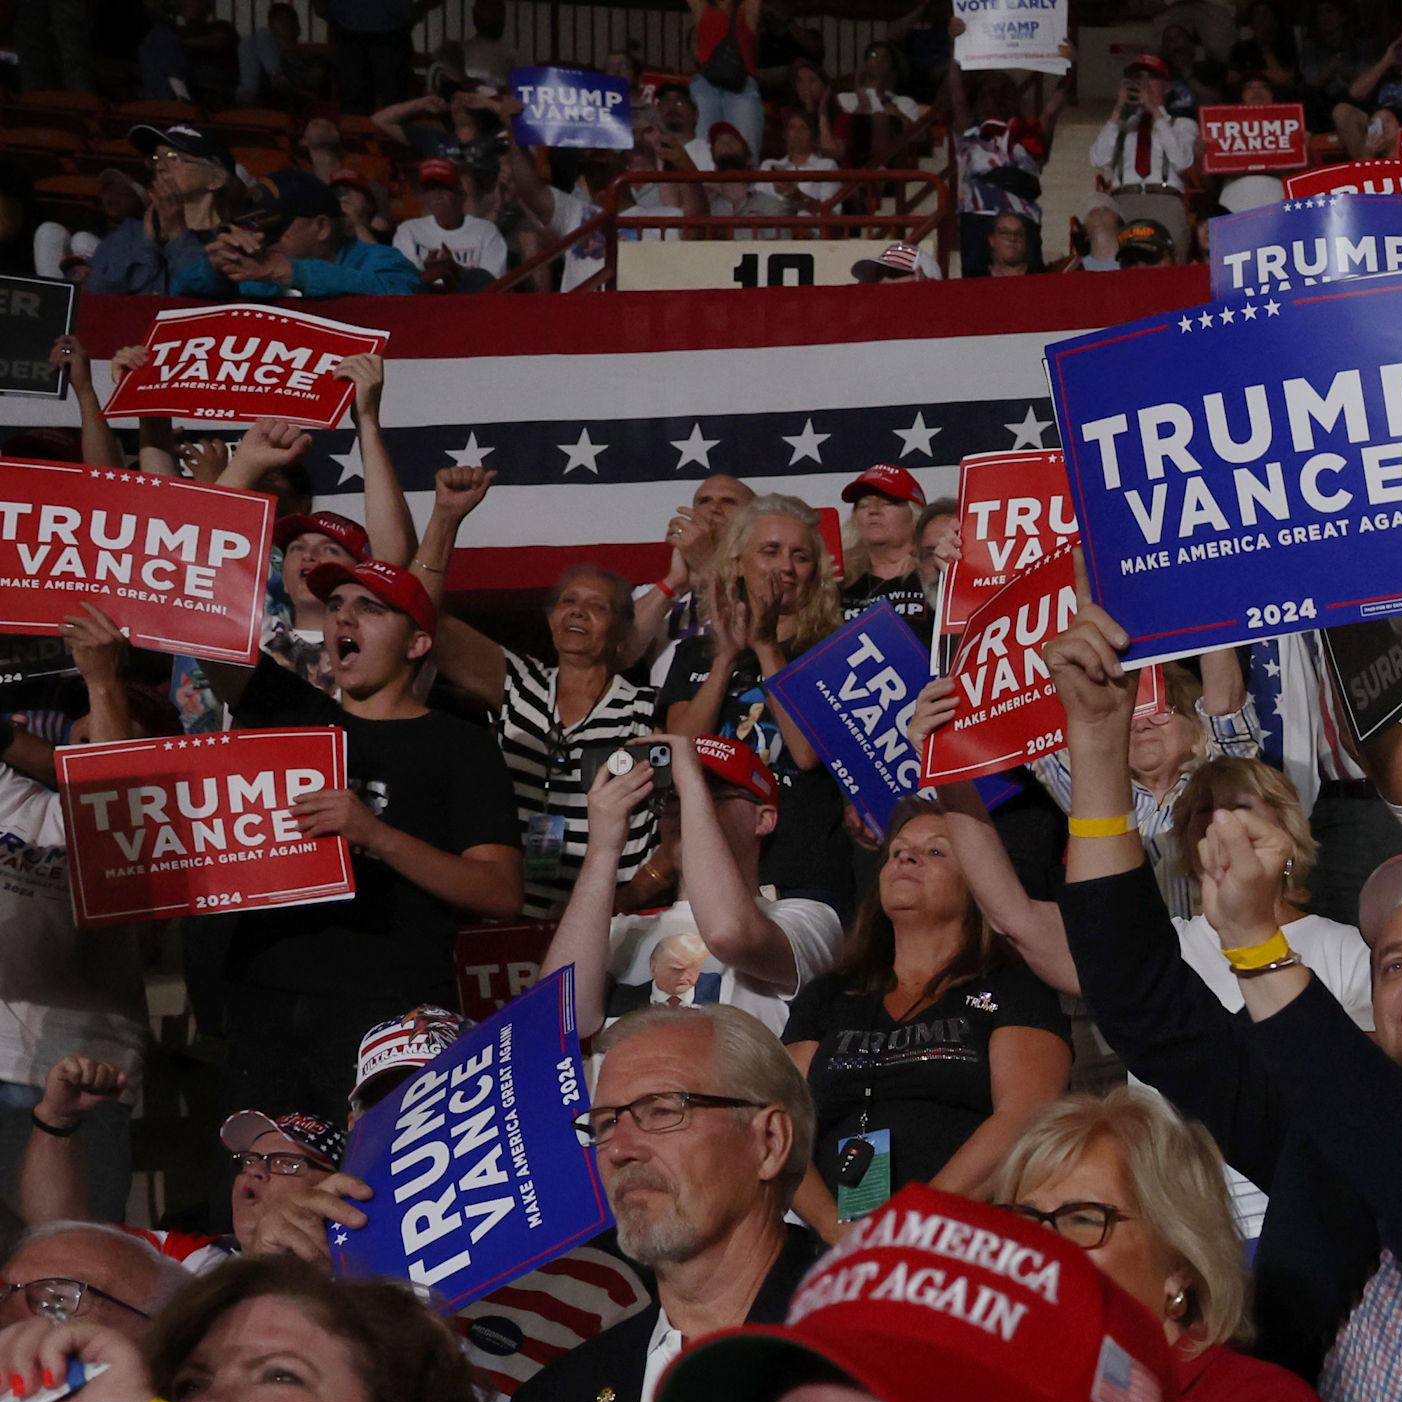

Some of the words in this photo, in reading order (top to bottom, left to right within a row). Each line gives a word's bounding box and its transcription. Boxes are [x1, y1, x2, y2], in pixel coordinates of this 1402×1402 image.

[517, 85, 623, 108] TRUMP
[528, 104, 613, 122] VANCE
[1206, 119, 1299, 140] TRUMP
[1218, 135, 1290, 151] VANCE
[151, 335, 346, 377] TRUMP
[159, 359, 321, 391] VANCE
[170, 381, 227, 391] AMERICA
[230, 383, 271, 395] GREAT
[273, 386, 321, 402] AGAIN!
[193, 407, 236, 419] 2024
[0, 502, 251, 568] TRUMP
[967, 495, 1080, 541] TRU
[1120, 550, 1171, 576] MAKE
[1176, 532, 1271, 567] AMERICA
[1277, 521, 1350, 547] GREAT
[15, 543, 217, 599] VANCE
[973, 575, 1006, 587] MAKE
[0, 577, 40, 590] MAKE
[44, 579, 111, 595] AMERICA
[117, 587, 168, 605] GREAT
[173, 598, 227, 616] AGAIN!
[1245, 597, 1318, 629] 2024
[955, 585, 1079, 678] TRU
[960, 641, 1054, 708] VAN
[954, 713, 988, 731] MAKE
[990, 690, 1041, 716] AMERICA
[815, 679, 843, 721] MAKE
[839, 713, 877, 763] AMERICA
[874, 759, 901, 795] GREAT
[1026, 729, 1063, 756] 2024
[830, 758, 860, 796] 2024
[80, 768, 326, 832] TRUMP
[112, 809, 302, 862] VANCE
[0, 855, 64, 879] ANCE
[105, 865, 145, 879] MAKE
[150, 856, 214, 874] AMERICA
[219, 848, 264, 865] GREAT
[269, 841, 318, 857] AGAIN!
[195, 892, 243, 909] 2024
[964, 994, 999, 1013] TRUMP
[401, 1043, 442, 1056] MAG
[498, 1023, 513, 1063] AGAIN!
[834, 1017, 970, 1055] TRUMP
[500, 1063, 517, 1107] GREAT
[555, 1056, 581, 1106] 2024
[450, 1043, 516, 1245] VANCE
[505, 1107, 534, 1180] AMERICA
[390, 1070, 471, 1298] TRUMP
[520, 1182, 543, 1230] MAKE
[863, 1209, 1061, 1305] AMERICA
[868, 1260, 1029, 1342] AGAIN
